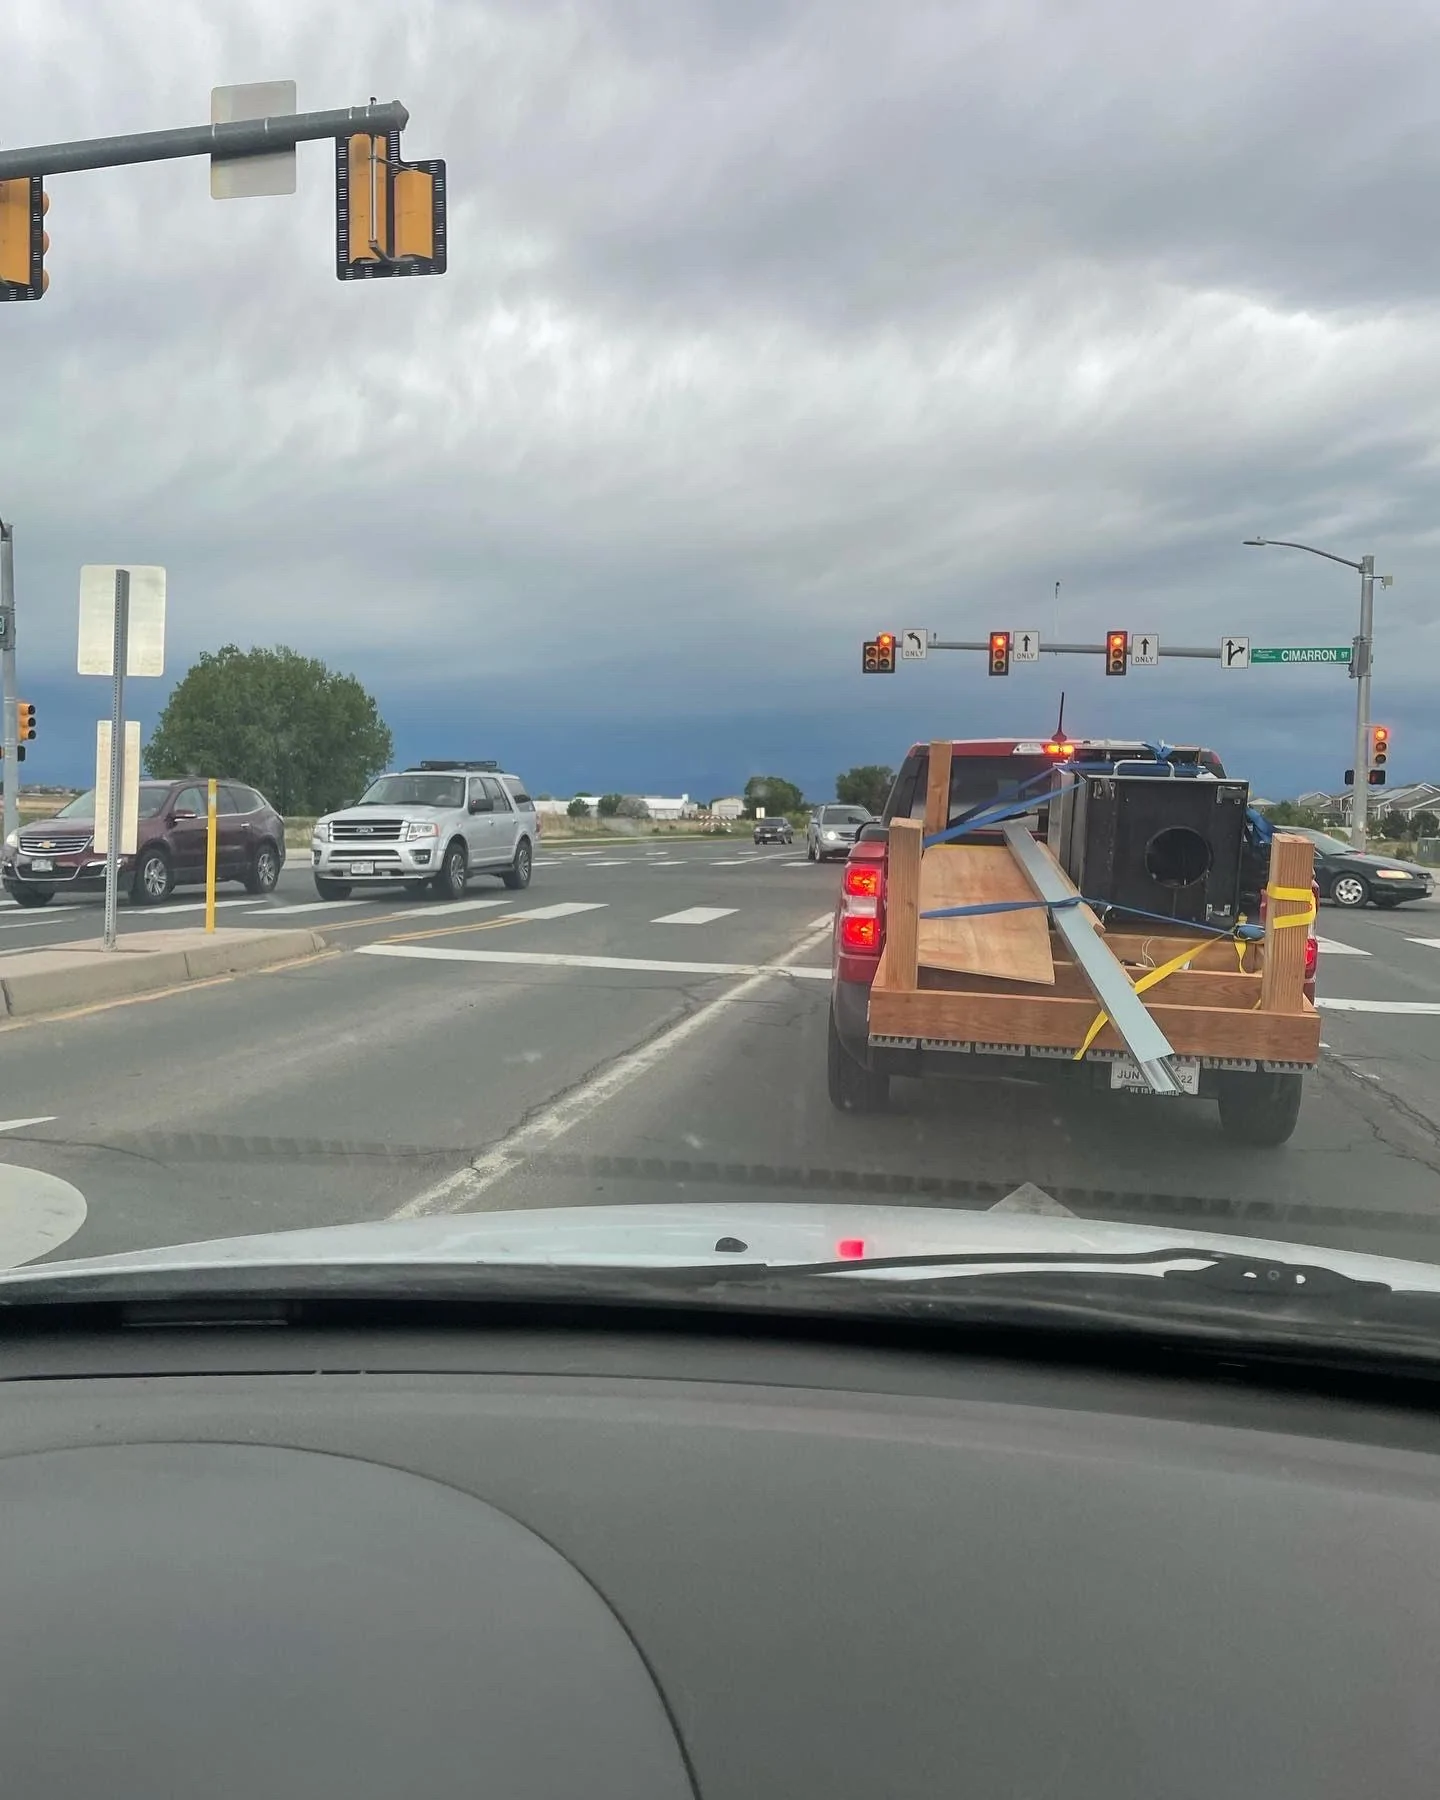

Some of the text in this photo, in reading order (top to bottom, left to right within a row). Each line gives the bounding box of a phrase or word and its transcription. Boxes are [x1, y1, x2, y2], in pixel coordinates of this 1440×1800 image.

[1281, 649, 1337, 661] CIMARRON
[1341, 651, 1349, 659] ST
[1117, 1070, 1140, 1080] JUN
